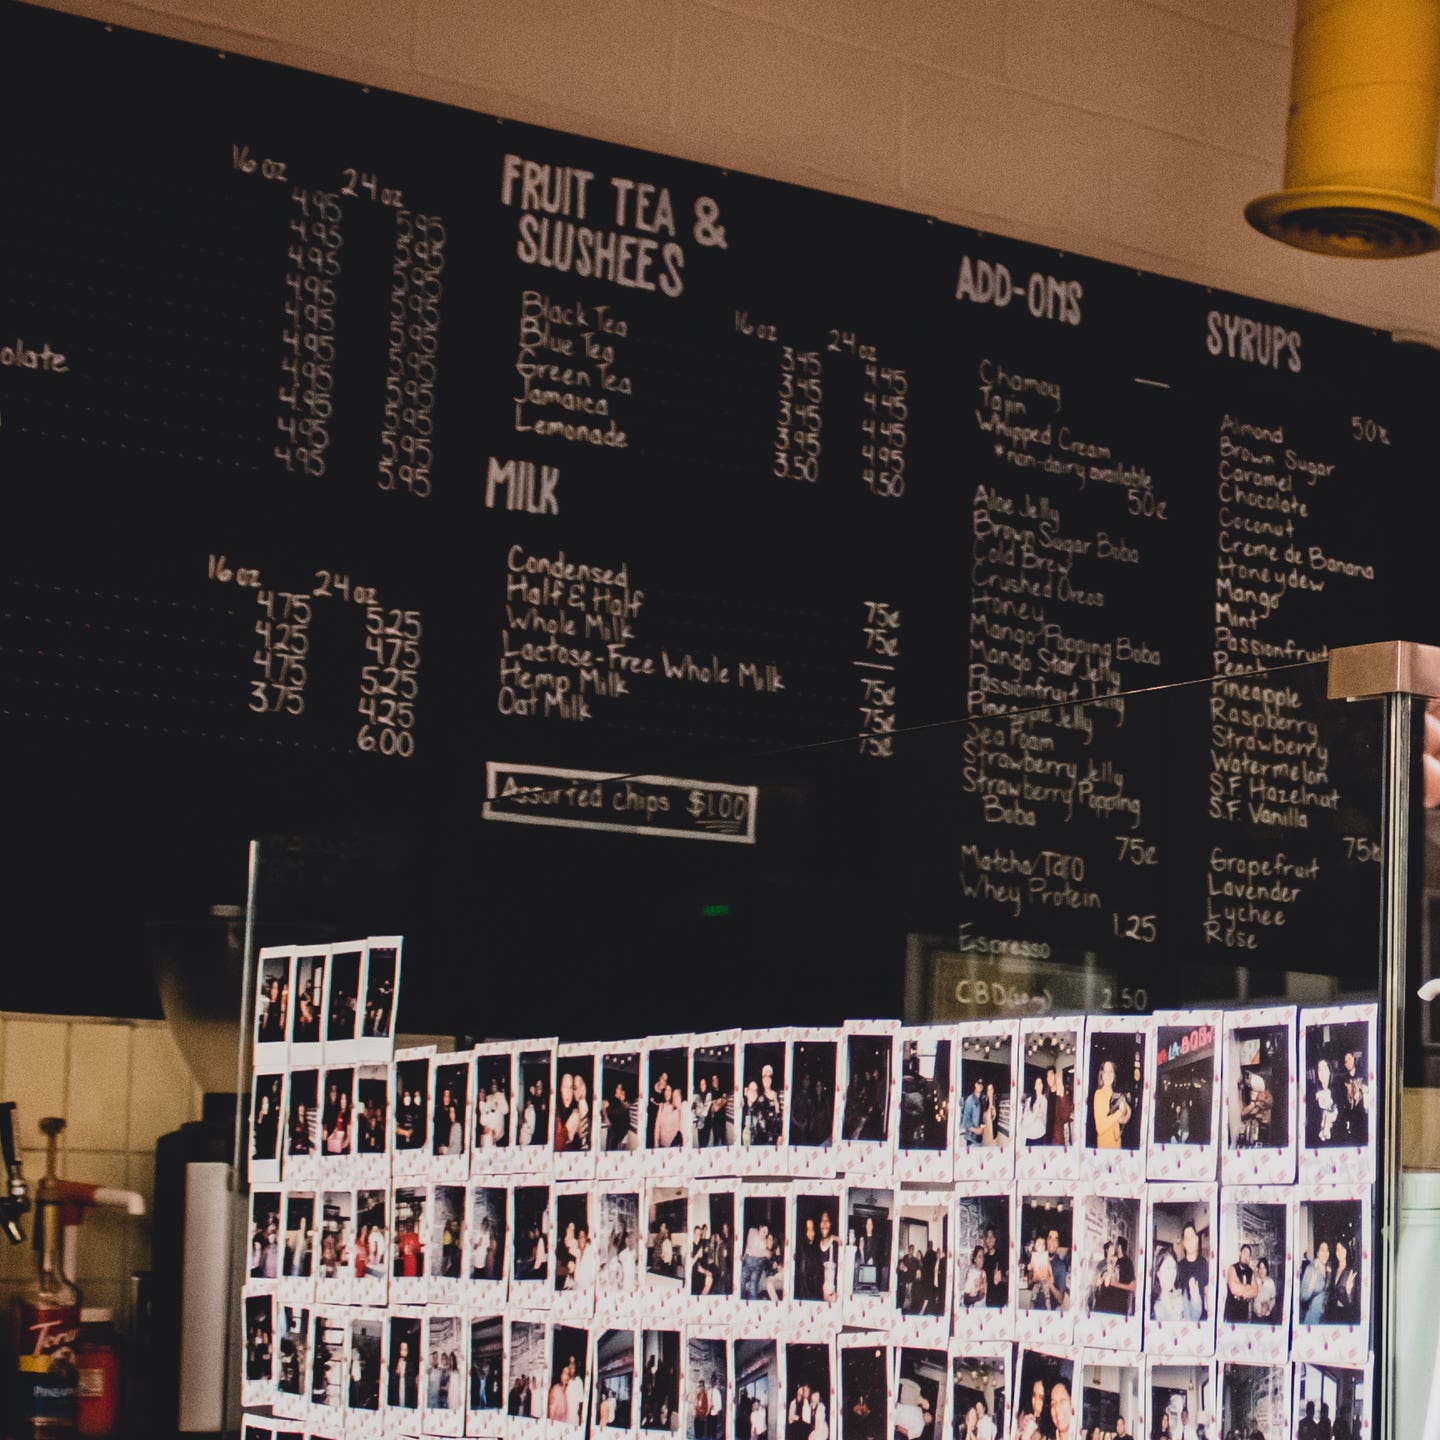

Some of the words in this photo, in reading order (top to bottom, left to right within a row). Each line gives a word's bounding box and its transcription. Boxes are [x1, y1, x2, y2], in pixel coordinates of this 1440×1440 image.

[232, 144, 258, 174] 16
[261, 159, 287, 181] oz
[340, 168, 378, 200] 24
[381, 187, 405, 208] oz
[500, 153, 596, 220] FRUIT
[610, 176, 678, 238] TEA
[692, 195, 729, 249] &
[517, 213, 686, 299] SLUSHEES
[520, 289, 589, 328] Black
[592, 304, 629, 338] Tea
[734, 309, 754, 336] 16
[756, 324, 778, 342] oz
[826, 328, 857, 354] 24
[519, 317, 577, 358] Blue
[580, 331, 615, 365] Tea
[1206, 309, 1302, 374] SYRUPS
[514, 348, 592, 388] Green
[595, 362, 633, 396] Tea
[978, 358, 1061, 413] Chamoy
[513, 377, 609, 417] Jamaica
[514, 398, 630, 449] Lemonade
[1058, 426, 1112, 461] Cream
[1218, 459, 1293, 492] Caramel
[1219, 435, 1276, 467] Brown
[1283, 449, 1337, 487] Sugar
[484, 455, 560, 516] MILK
[1218, 482, 1310, 519] Chocolate
[1218, 506, 1296, 538] Coconut
[207, 553, 234, 583] 16
[235, 567, 262, 587] oz
[312, 569, 351, 601] 24
[353, 586, 380, 605] oz
[506, 544, 630, 589] Condensed
[1217, 555, 1326, 598] Honeydew
[1283, 543, 1305, 566] de
[1307, 545, 1376, 581] Banana
[506, 572, 565, 607] Half
[591, 585, 646, 619] Half
[1214, 601, 1261, 629] Mint
[1215, 577, 1281, 620] Mango
[505, 604, 578, 637] Whole
[584, 612, 636, 642] Milk
[501, 629, 657, 675] Lactose-Free
[660, 648, 731, 685] Whole
[738, 661, 786, 693] Milk
[1214, 626, 1329, 664] Passionfruit
[499, 657, 572, 699] Hemp
[579, 666, 631, 699] Milk
[497, 684, 539, 717] Oat
[543, 692, 593, 722] Milk
[1209, 696, 1320, 746] Raspberry
[1209, 749, 1329, 785] Watermelon
[1211, 723, 1329, 771] Strawberry
[611, 782, 671, 822] chips
[982, 793, 1037, 827] Boba
[1249, 776, 1342, 811] Hazelnut
[1246, 802, 1309, 829] Vanilla
[1207, 871, 1302, 904] Lavender
[1210, 847, 1321, 886] Grapefruit
[960, 870, 1022, 918] Whey
[1028, 876, 1103, 910] Protein
[1206, 895, 1287, 934] Lychee
[959, 921, 1052, 963] Espresso
[1203, 918, 1259, 951] Rose
